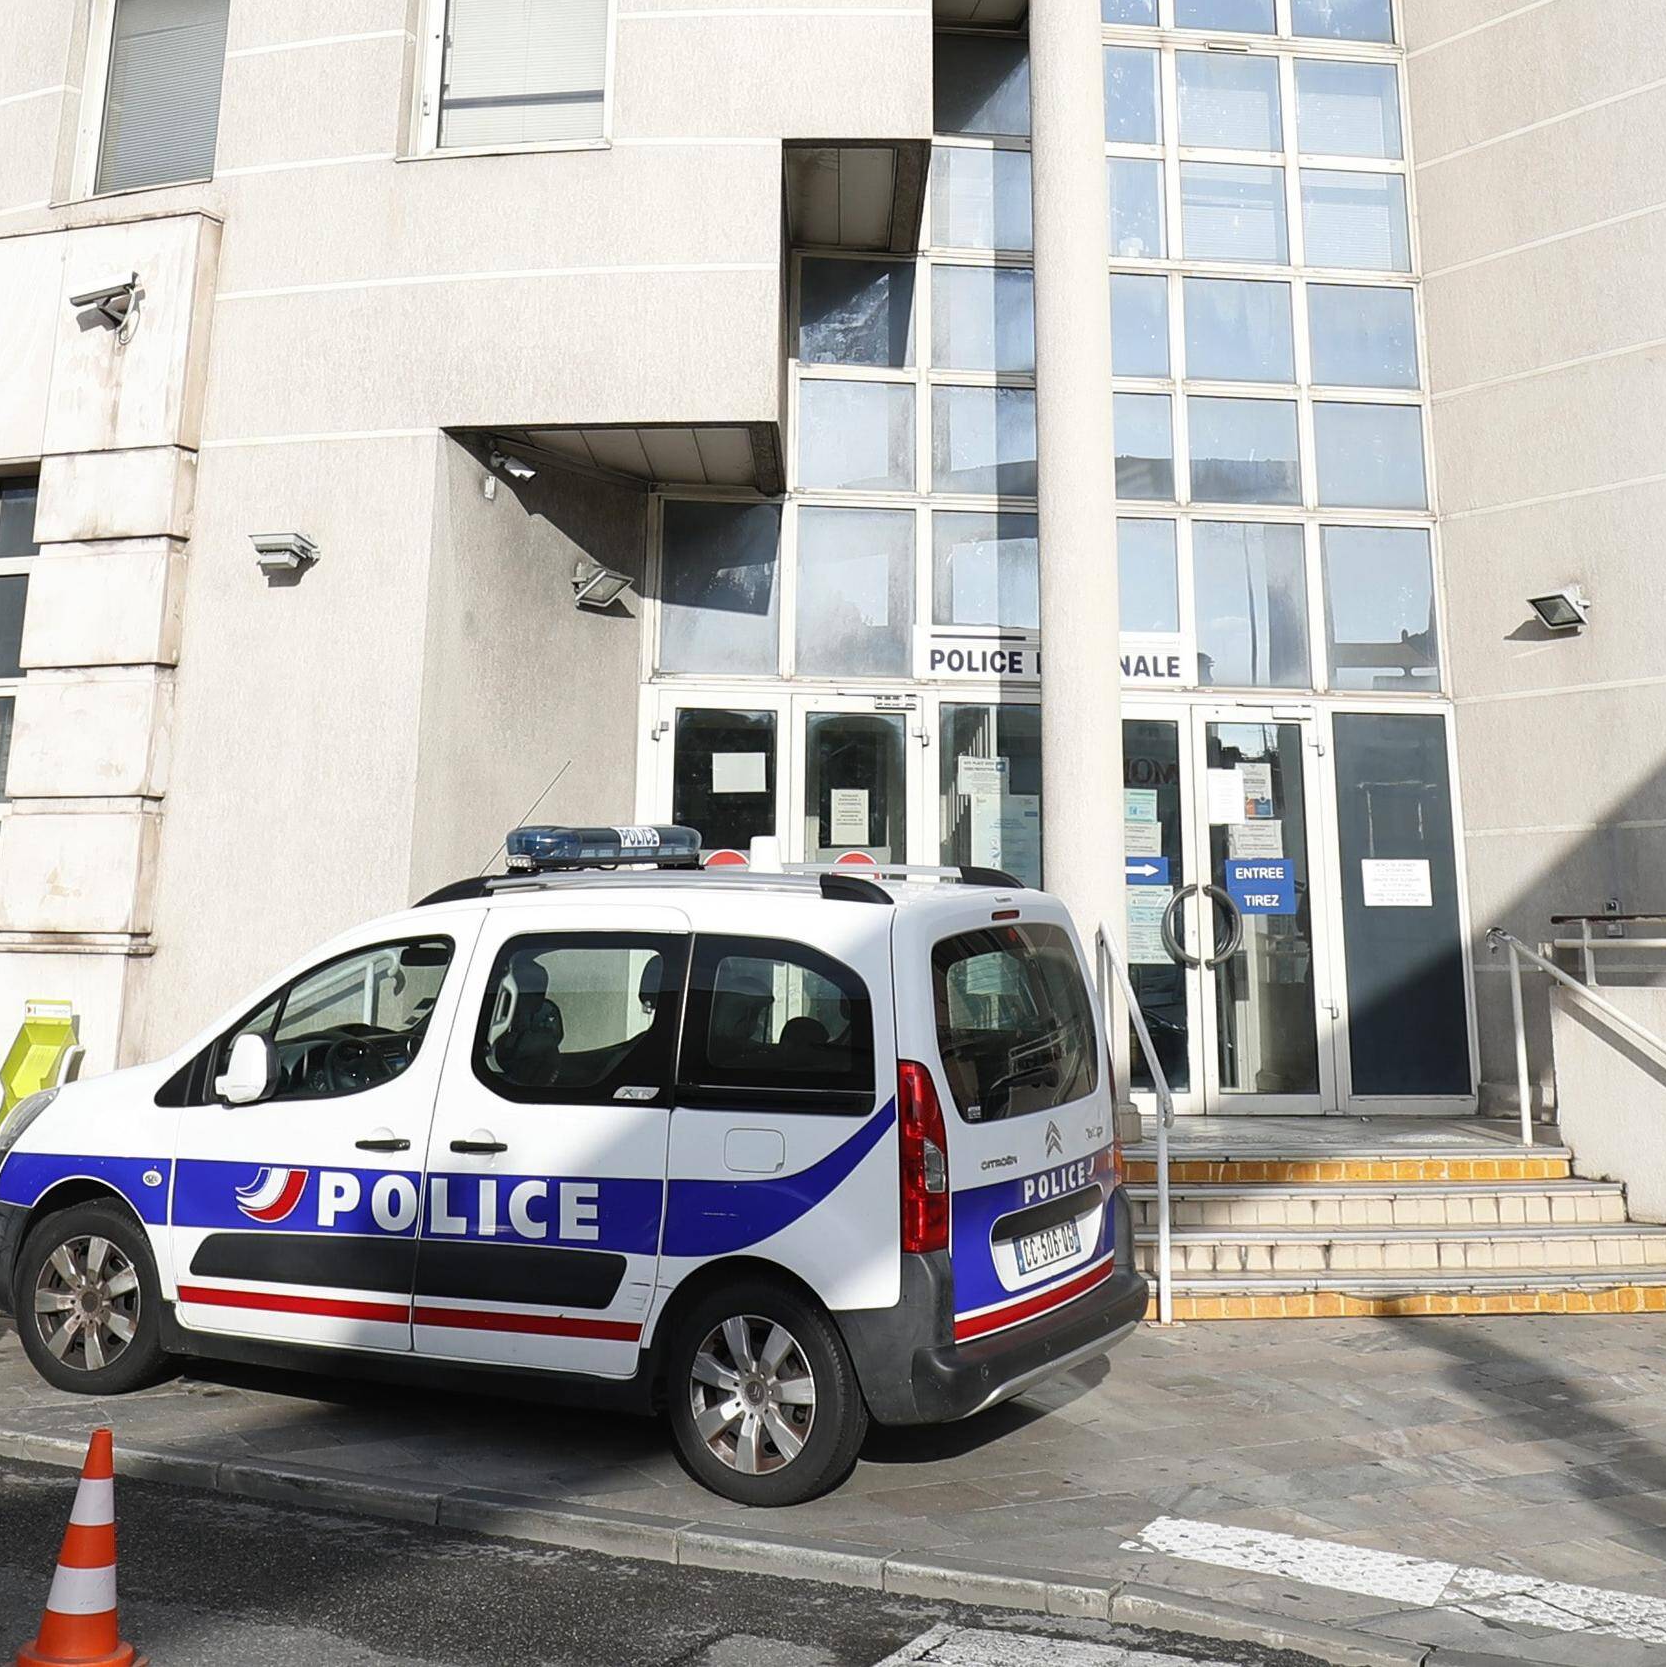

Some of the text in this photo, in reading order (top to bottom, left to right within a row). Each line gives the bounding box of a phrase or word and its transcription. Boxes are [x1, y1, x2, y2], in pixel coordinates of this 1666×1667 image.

[930, 649, 1023, 674] POLICE
[619, 828, 658, 846] POLICE
[1235, 867, 1284, 880] ENTREE
[1244, 894, 1280, 907] TIREZ
[1024, 1162, 1086, 1204] POLICE
[317, 1171, 599, 1240] POLICE
